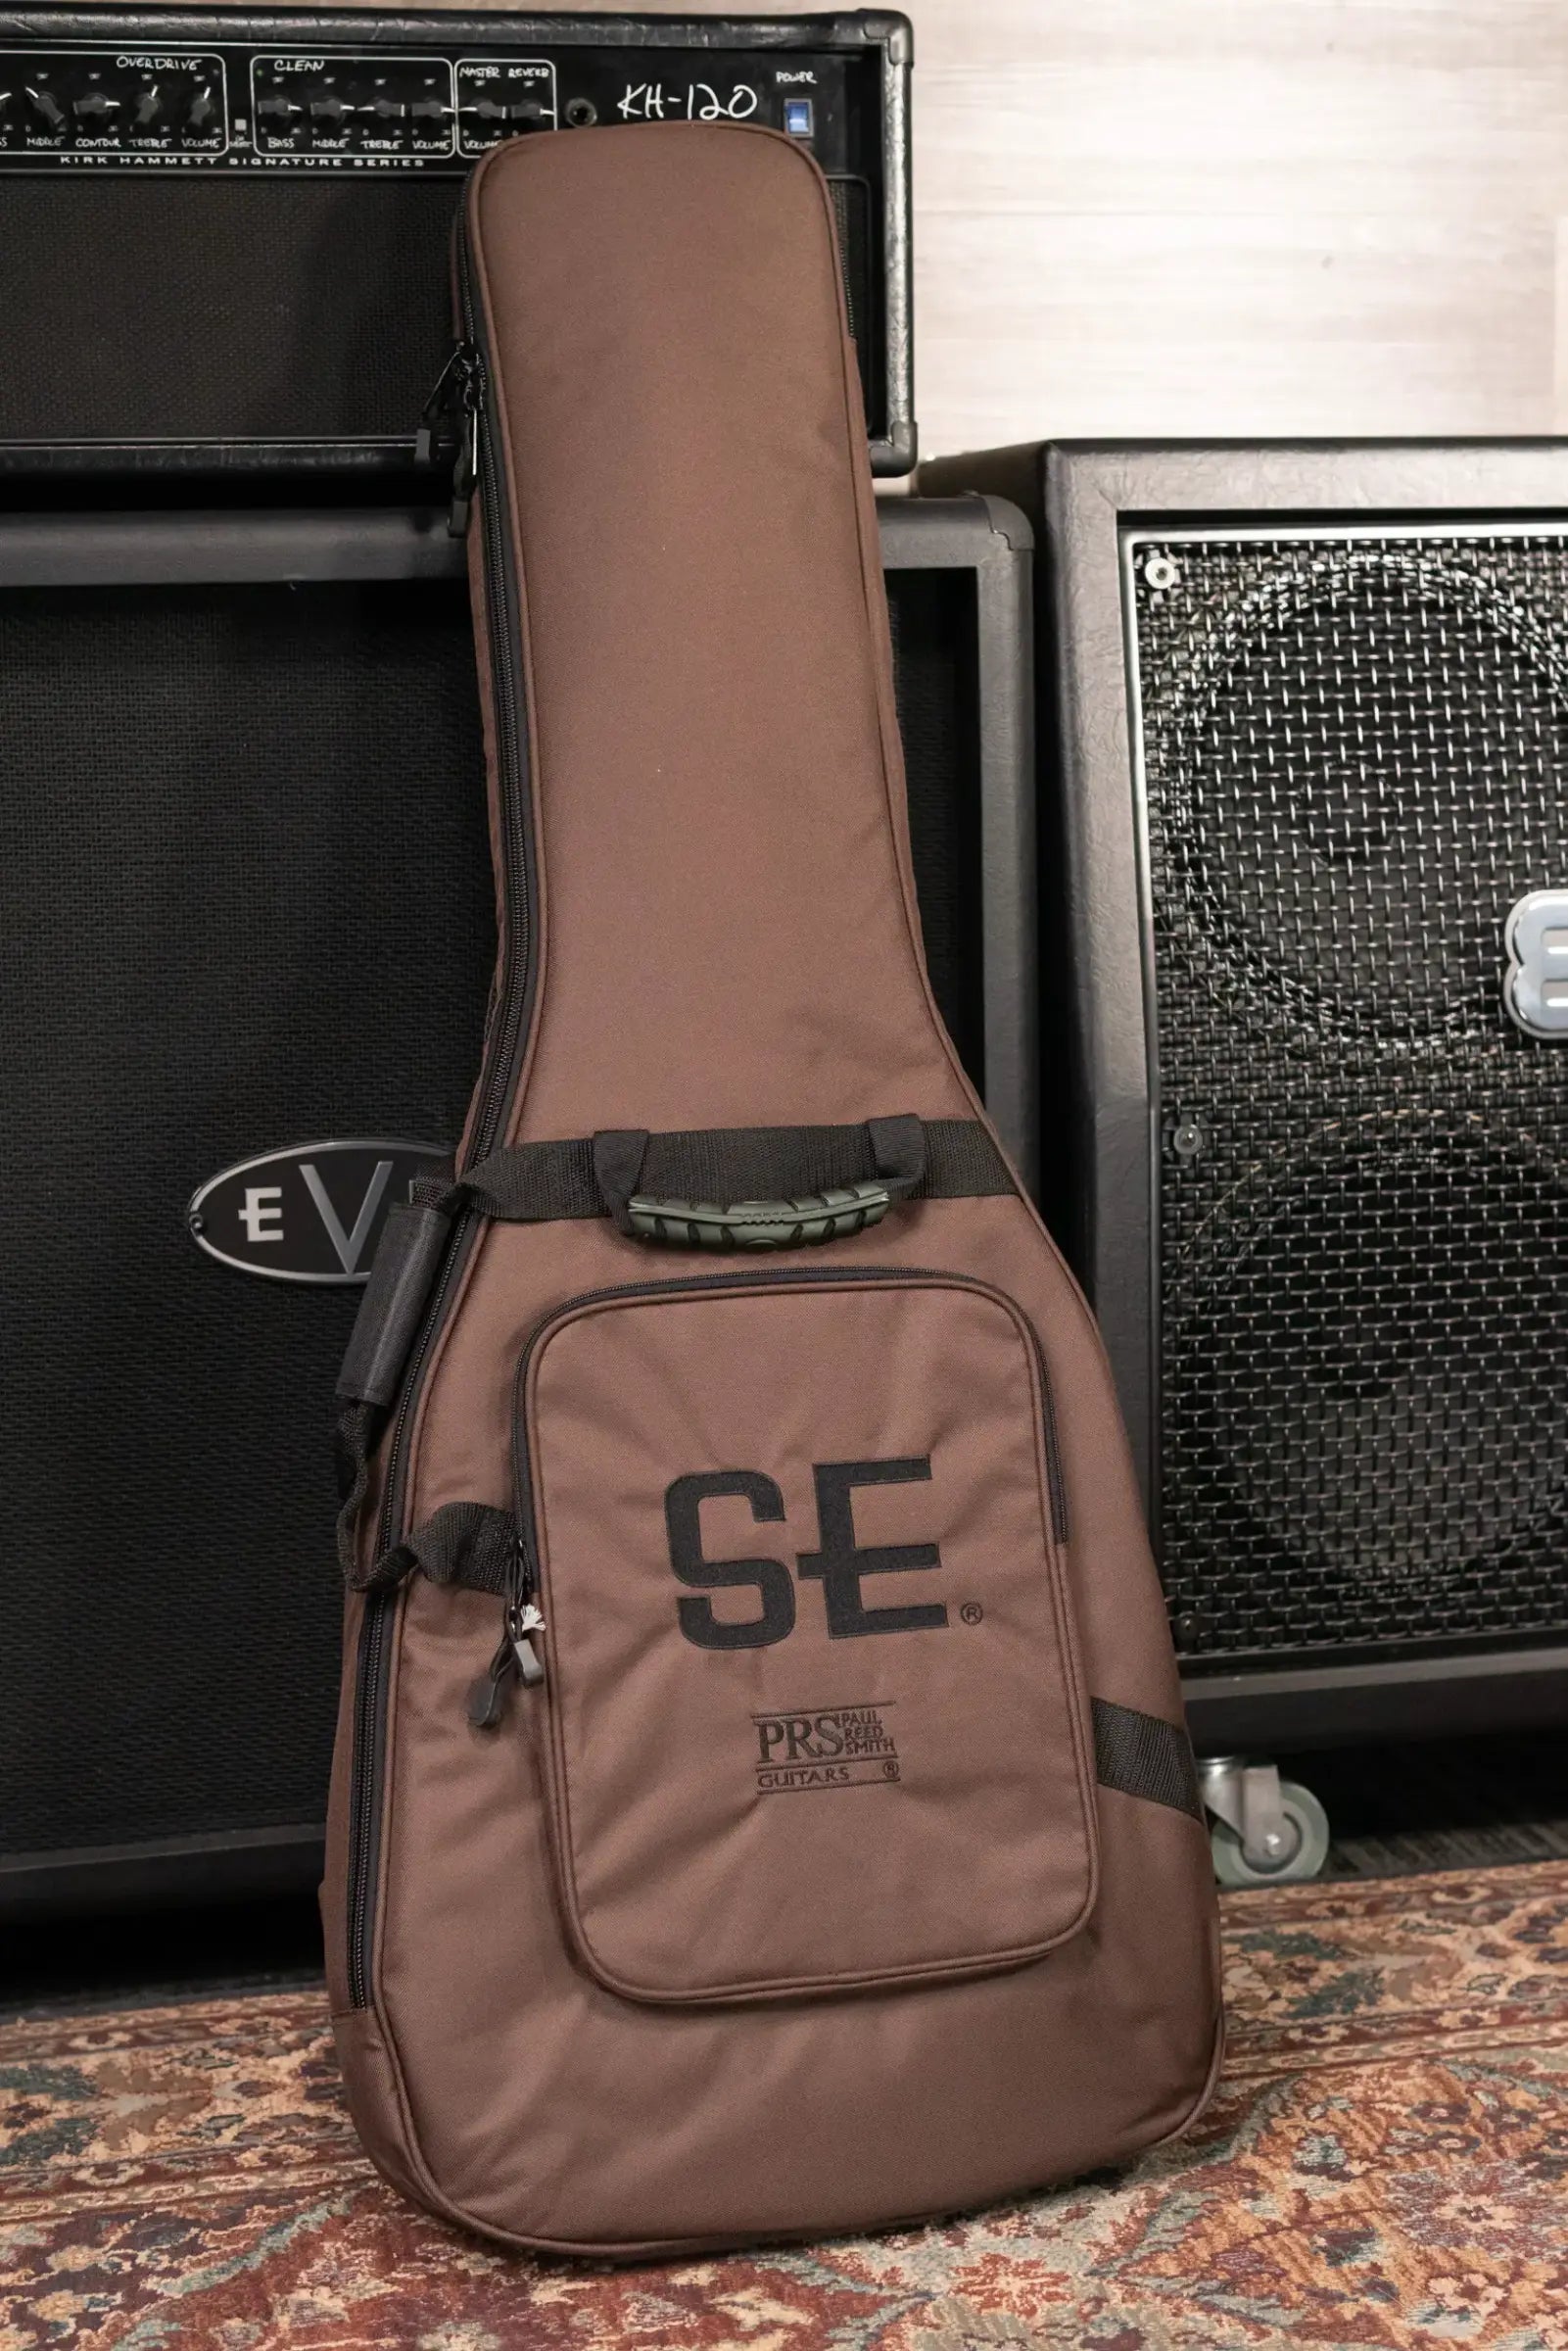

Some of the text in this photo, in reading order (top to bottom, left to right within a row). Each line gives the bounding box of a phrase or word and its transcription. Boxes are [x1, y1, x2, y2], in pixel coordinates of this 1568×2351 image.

[116, 55, 202, 71] OVERDRIVE
[273, 59, 325, 72] CLEAN
[458, 66, 549, 78] MASTER REVERB
[776, 71, 818, 84] POWER
[617, 82, 758, 120] KH-120
[74, 137, 121, 148] CONTOUR
[128, 137, 172, 149] TREBLE
[181, 137, 222, 149] VOLUME
[267, 136, 295, 149] BASS
[359, 139, 404, 151] TREBLE
[412, 139, 452, 151] VOLUME
[60, 156, 424, 168] KIRK HAMMETT SIGNATURE SERIES
[664, 1454, 950, 1651] SE
[839, 1709, 882, 1726] PAUL
[752, 1714, 843, 1764] PRS
[843, 1725, 884, 1740] REED
[844, 1737, 896, 1755] SMITH
[757, 1766, 850, 1788] GUITARS
